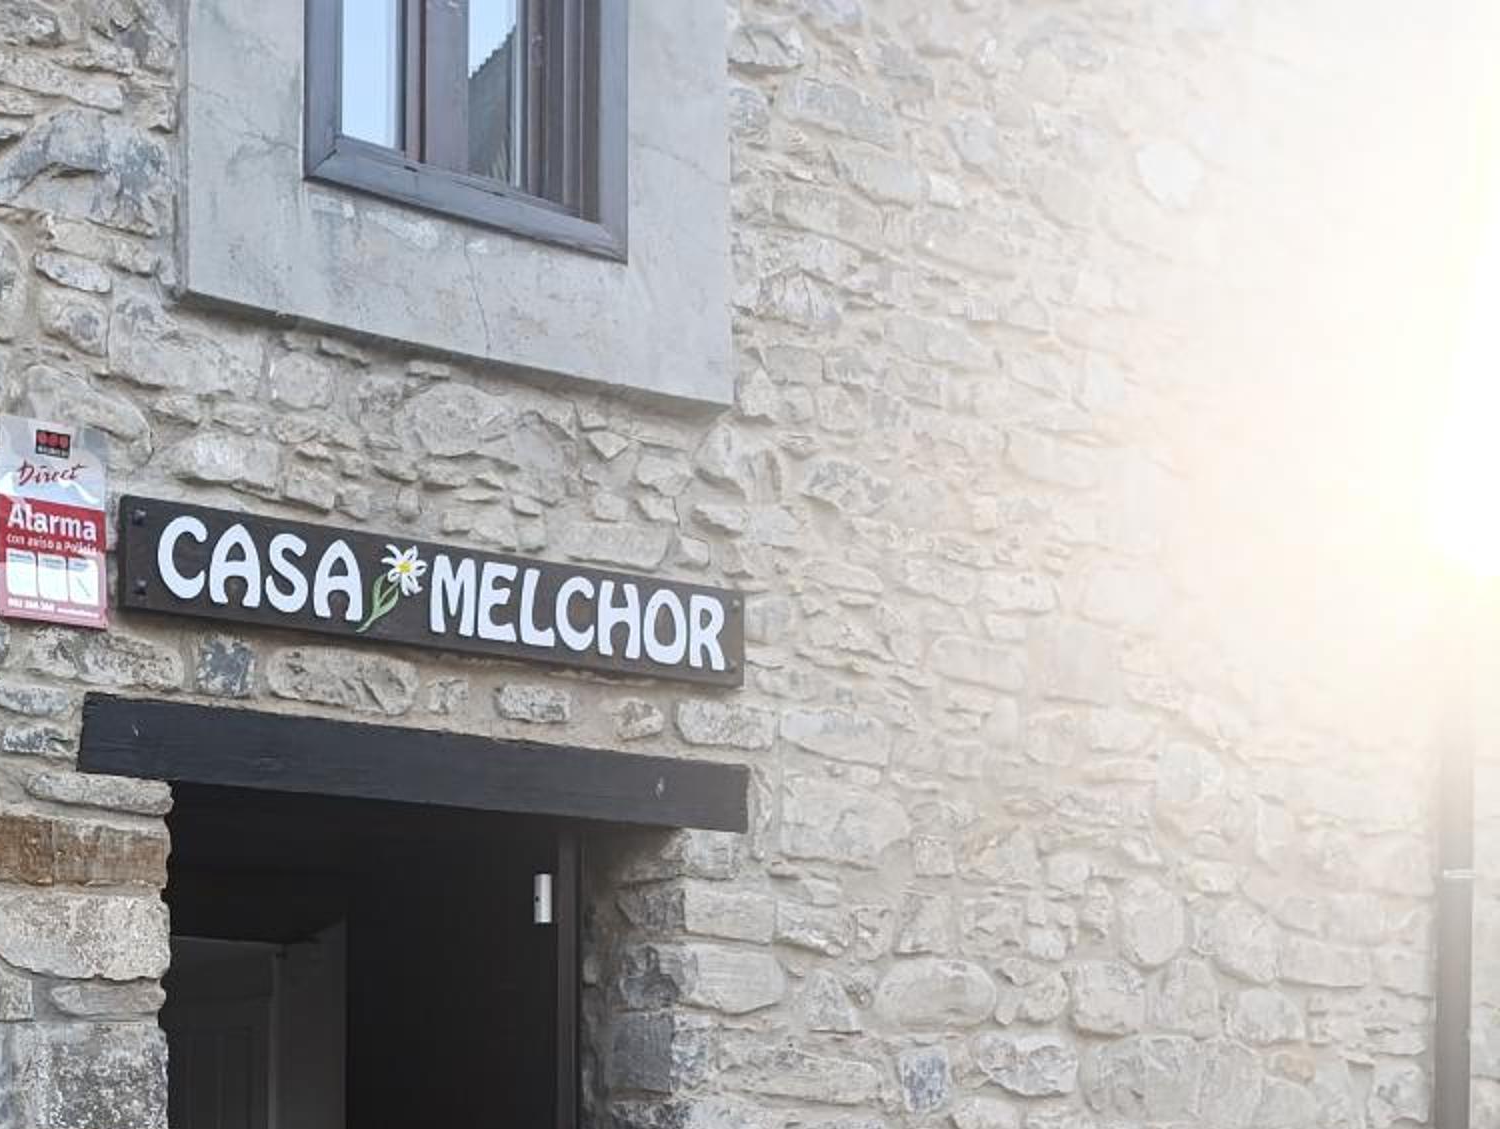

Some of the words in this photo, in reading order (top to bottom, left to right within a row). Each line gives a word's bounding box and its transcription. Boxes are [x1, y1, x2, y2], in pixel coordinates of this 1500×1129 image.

[17, 459, 88, 487] Direct
[7, 503, 97, 542] Alarma
[157, 514, 363, 621] CASA
[430, 554, 726, 671] MELCHOR
